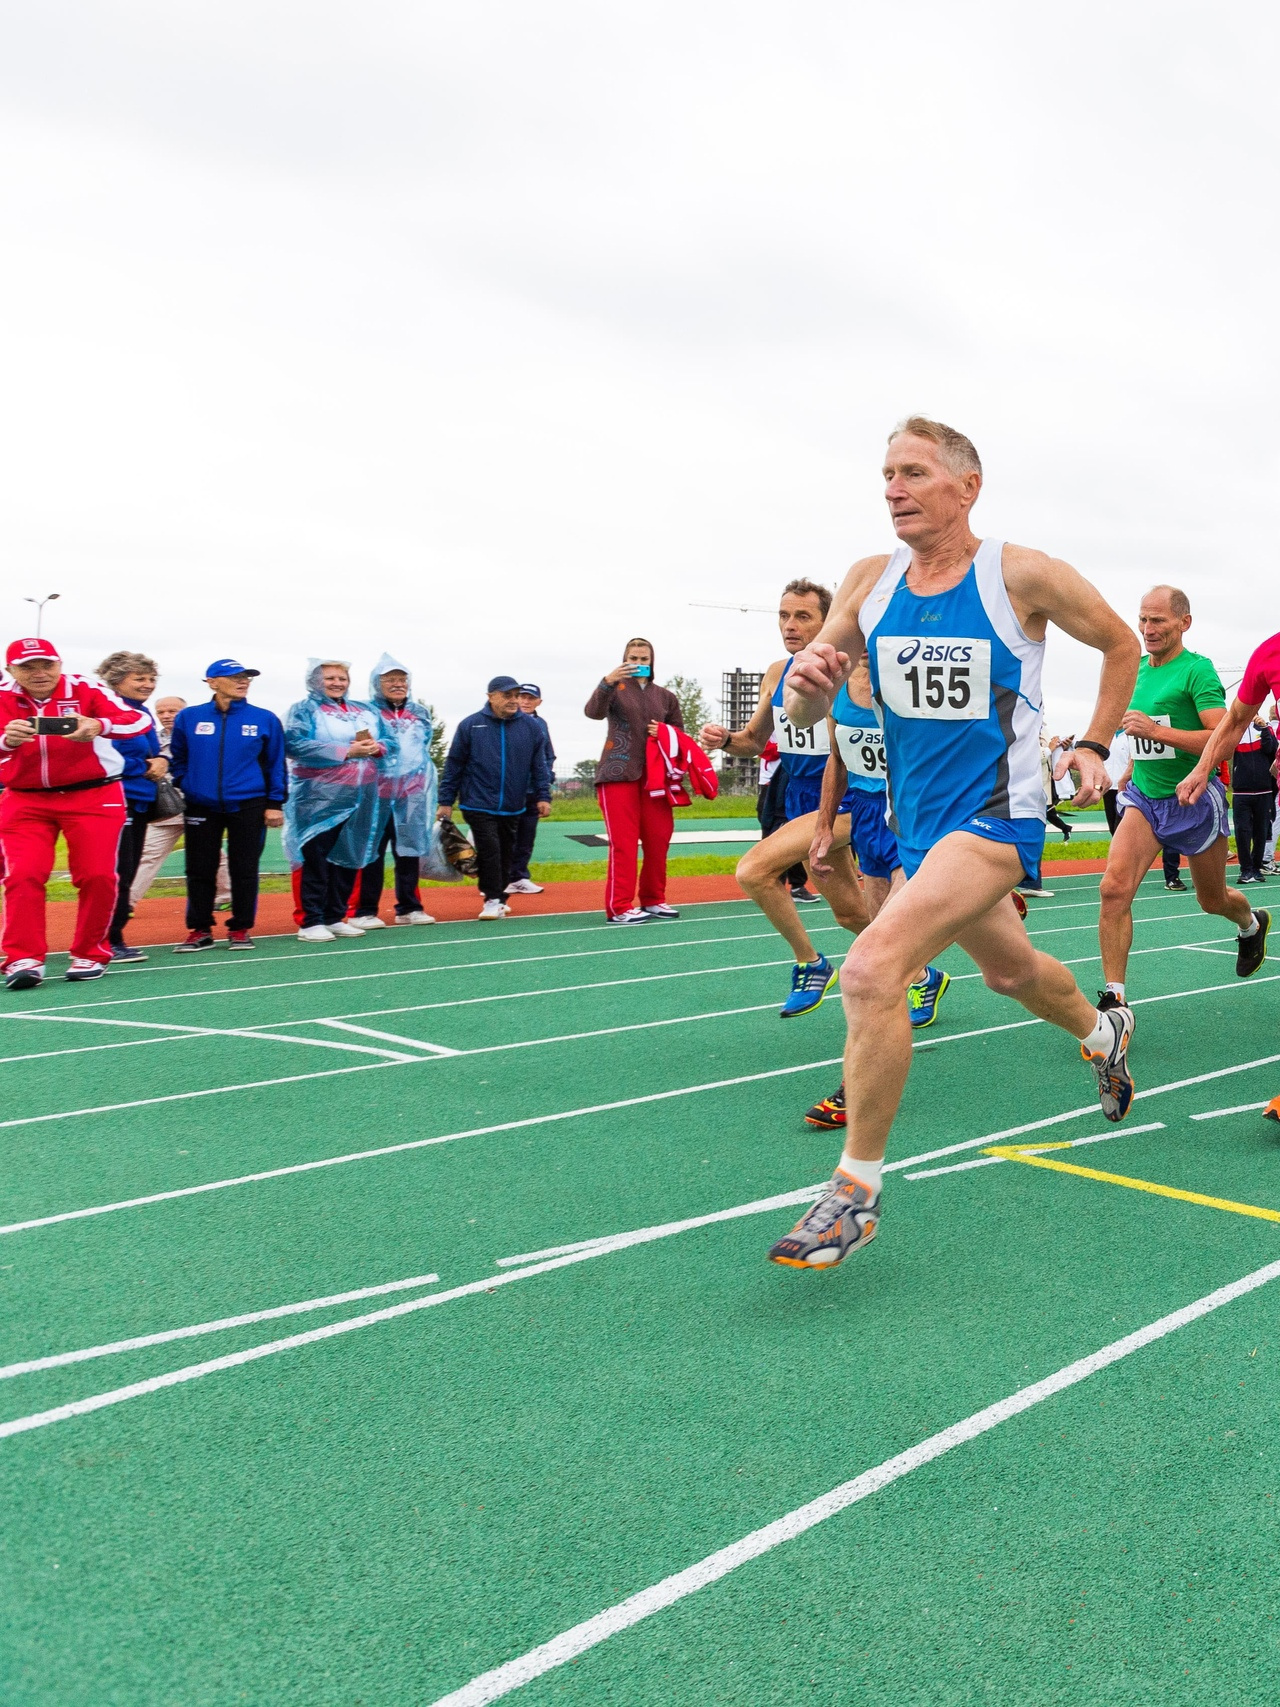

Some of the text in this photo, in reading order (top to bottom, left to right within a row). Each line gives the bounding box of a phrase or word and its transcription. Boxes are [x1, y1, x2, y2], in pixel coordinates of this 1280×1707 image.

[921, 645, 973, 662] asics
[904, 665, 971, 709] 155
[784, 724, 815, 749] 151
[864, 732, 884, 745] asi
[1134, 735, 1165, 755] 105
